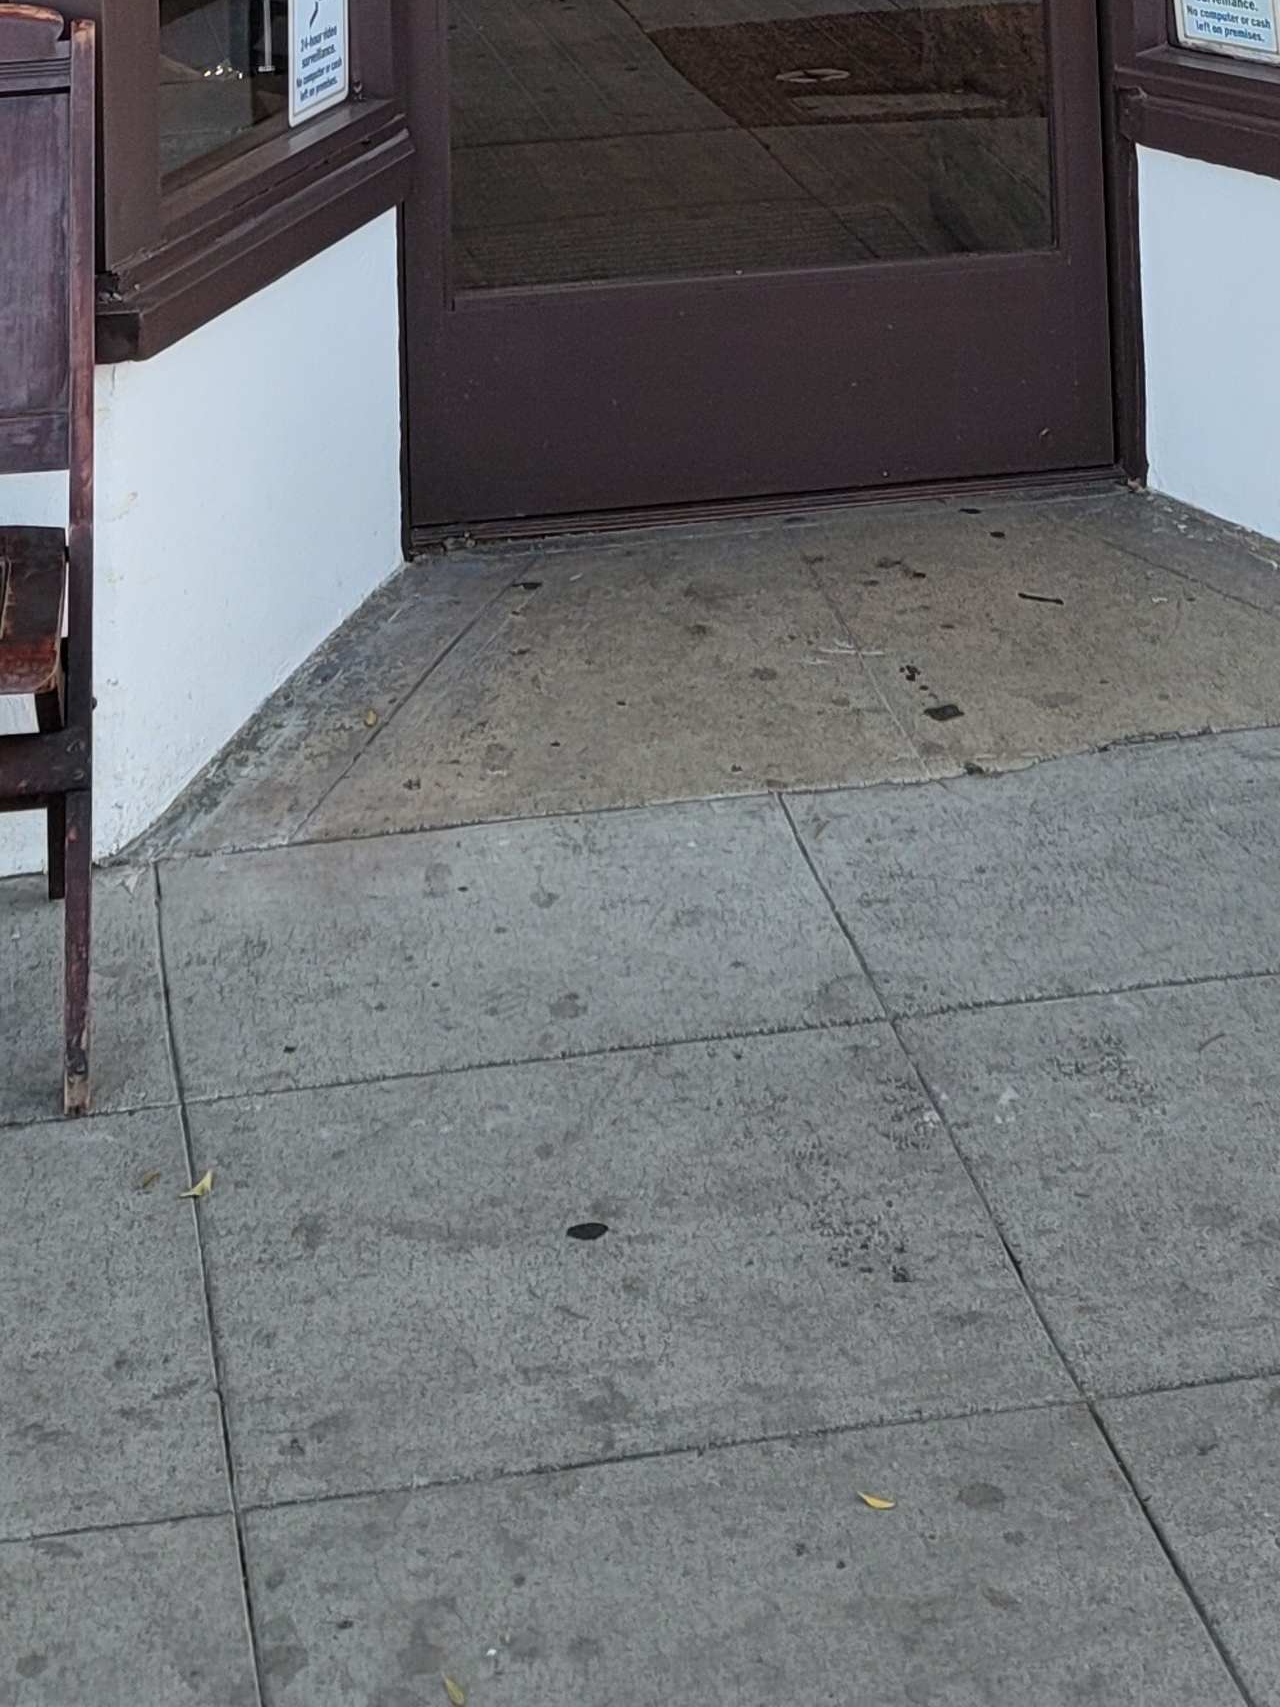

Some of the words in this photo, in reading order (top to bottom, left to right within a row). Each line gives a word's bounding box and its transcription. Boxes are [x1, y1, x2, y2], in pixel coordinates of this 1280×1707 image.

[1186, 4, 1199, 18] No
[1200, 8, 1240, 25] computer
[1240, 15, 1251, 25] or
[1251, 16, 1271, 29] cash
[1195, 19, 1211, 32] left
[1224, 25, 1266, 43] premises.
